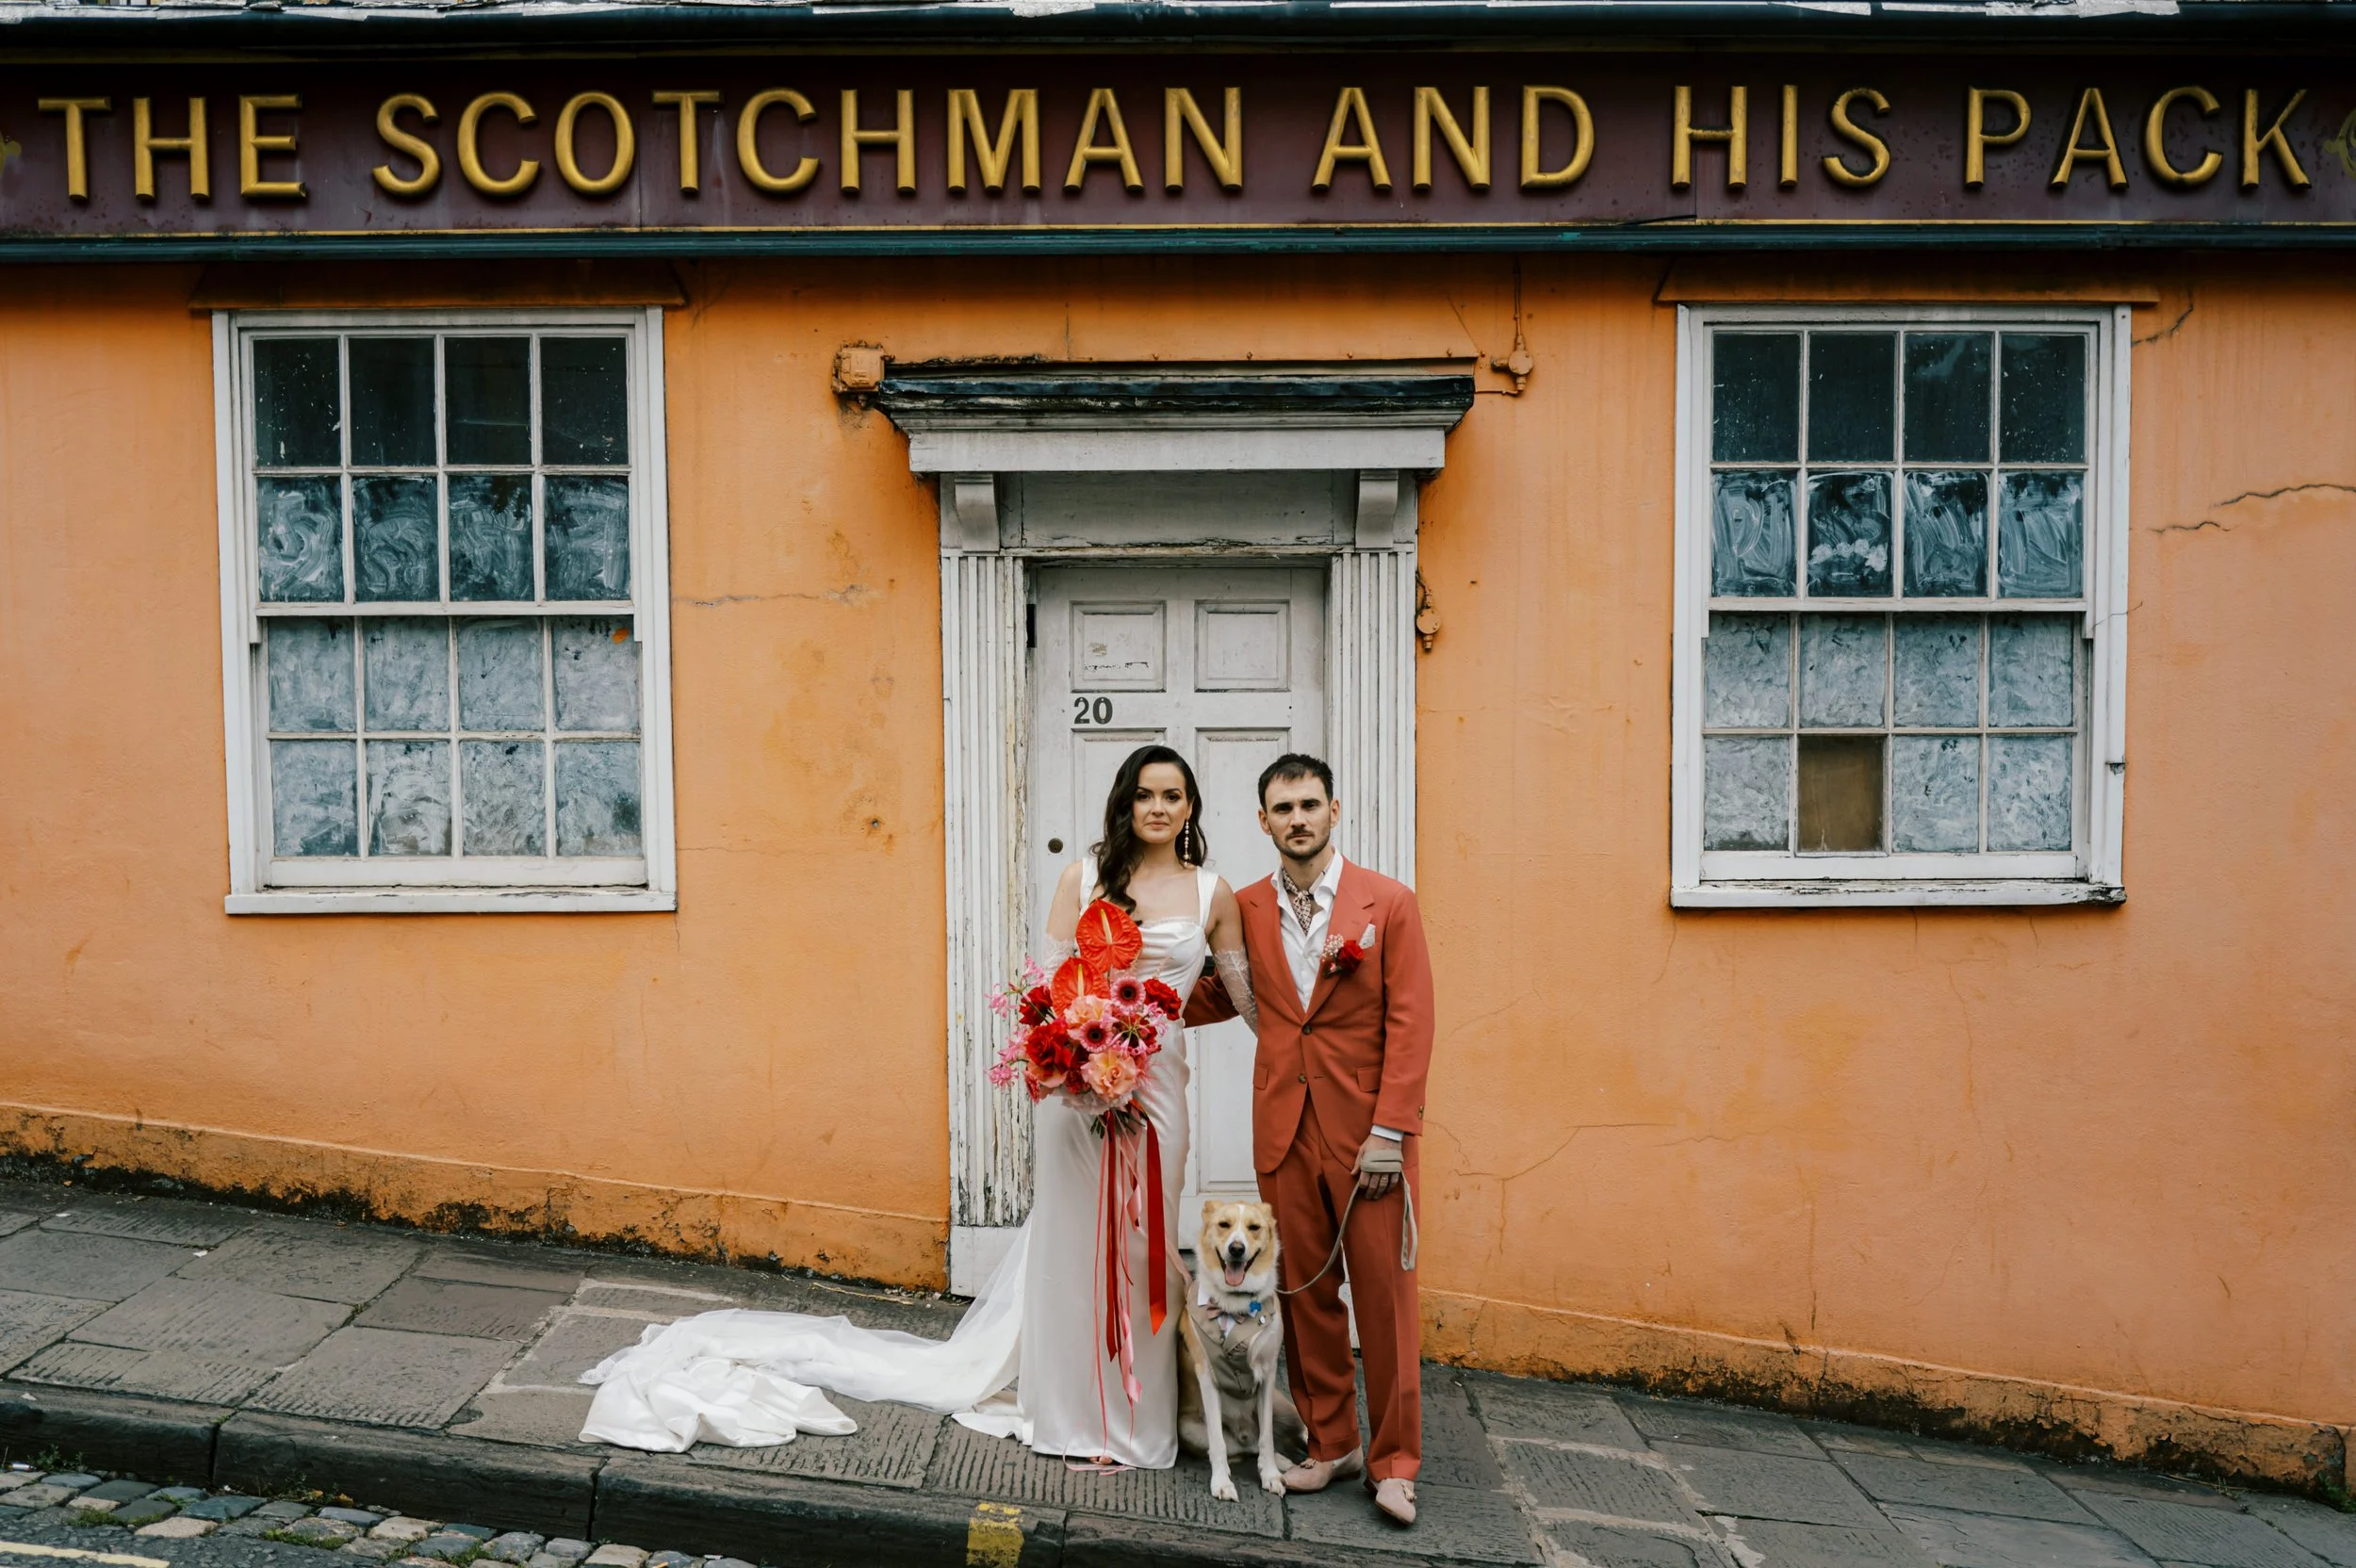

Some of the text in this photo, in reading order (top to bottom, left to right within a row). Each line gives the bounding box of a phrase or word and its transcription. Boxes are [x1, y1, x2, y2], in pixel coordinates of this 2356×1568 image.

[38, 84, 2312, 201] THE SCOTCHMAN AND HIS PACK
[1073, 695, 1113, 725] 20
